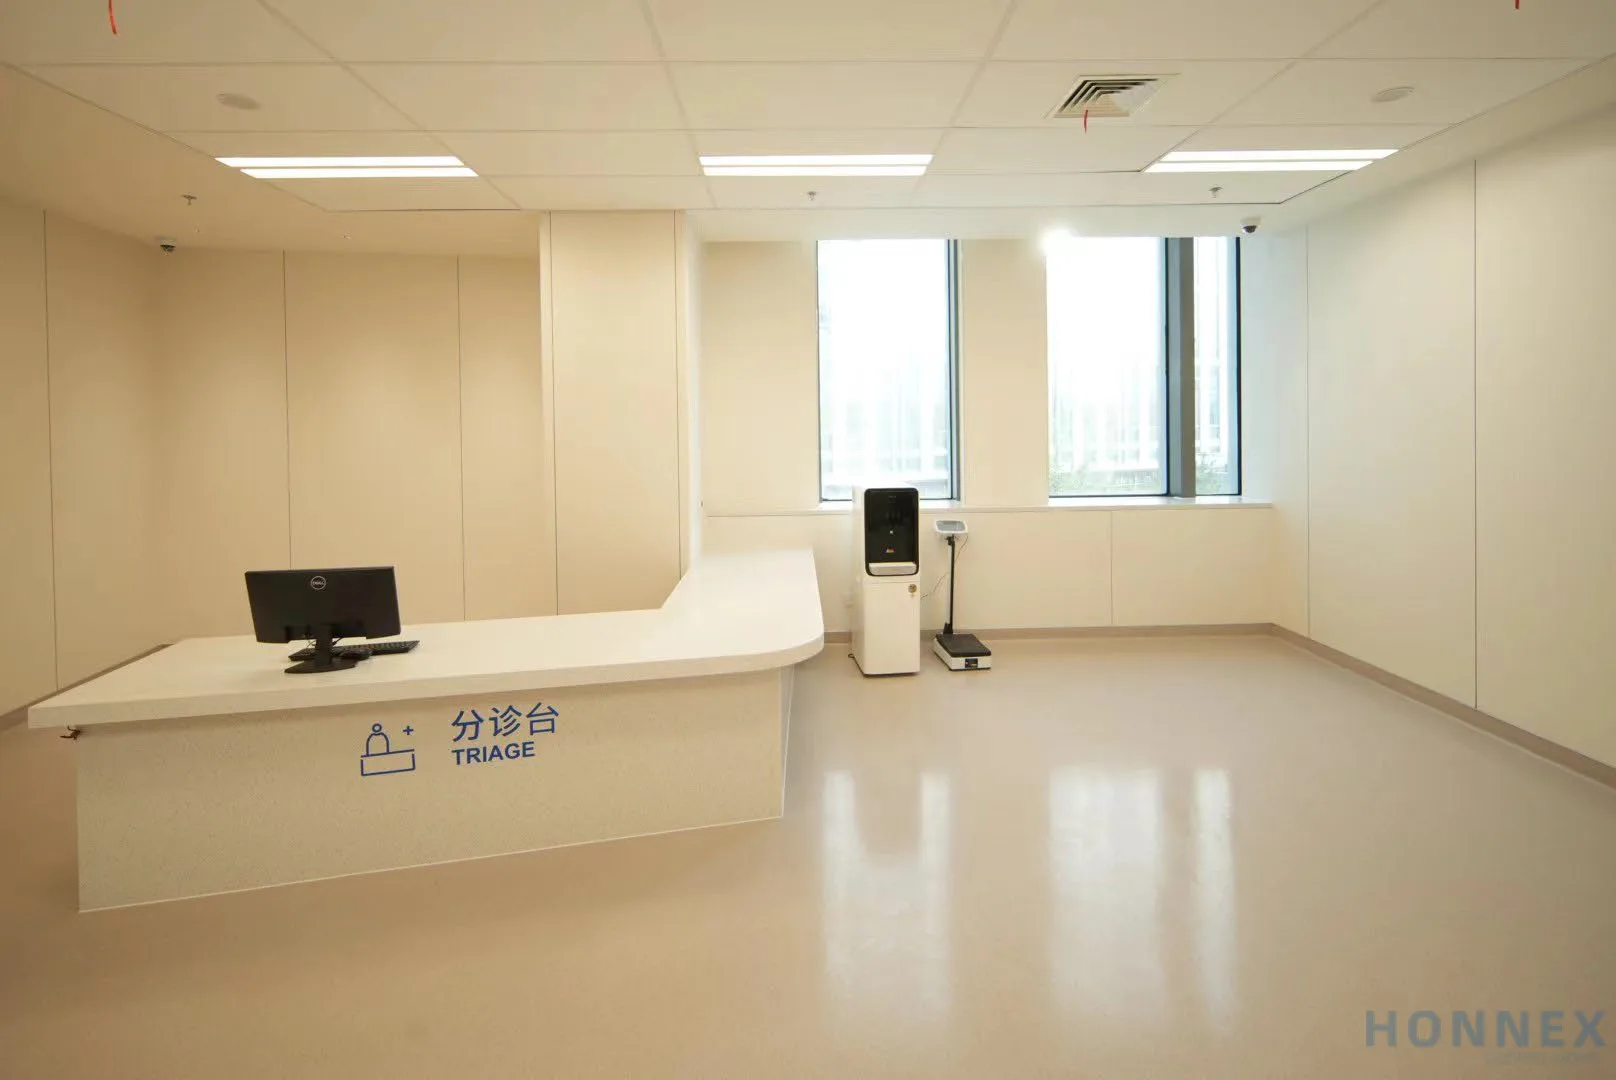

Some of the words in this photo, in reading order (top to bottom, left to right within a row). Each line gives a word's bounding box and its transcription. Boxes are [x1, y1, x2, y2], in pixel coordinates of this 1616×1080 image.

[451, 702, 559, 742] 分诊台
[451, 741, 535, 765] TRIAGE
